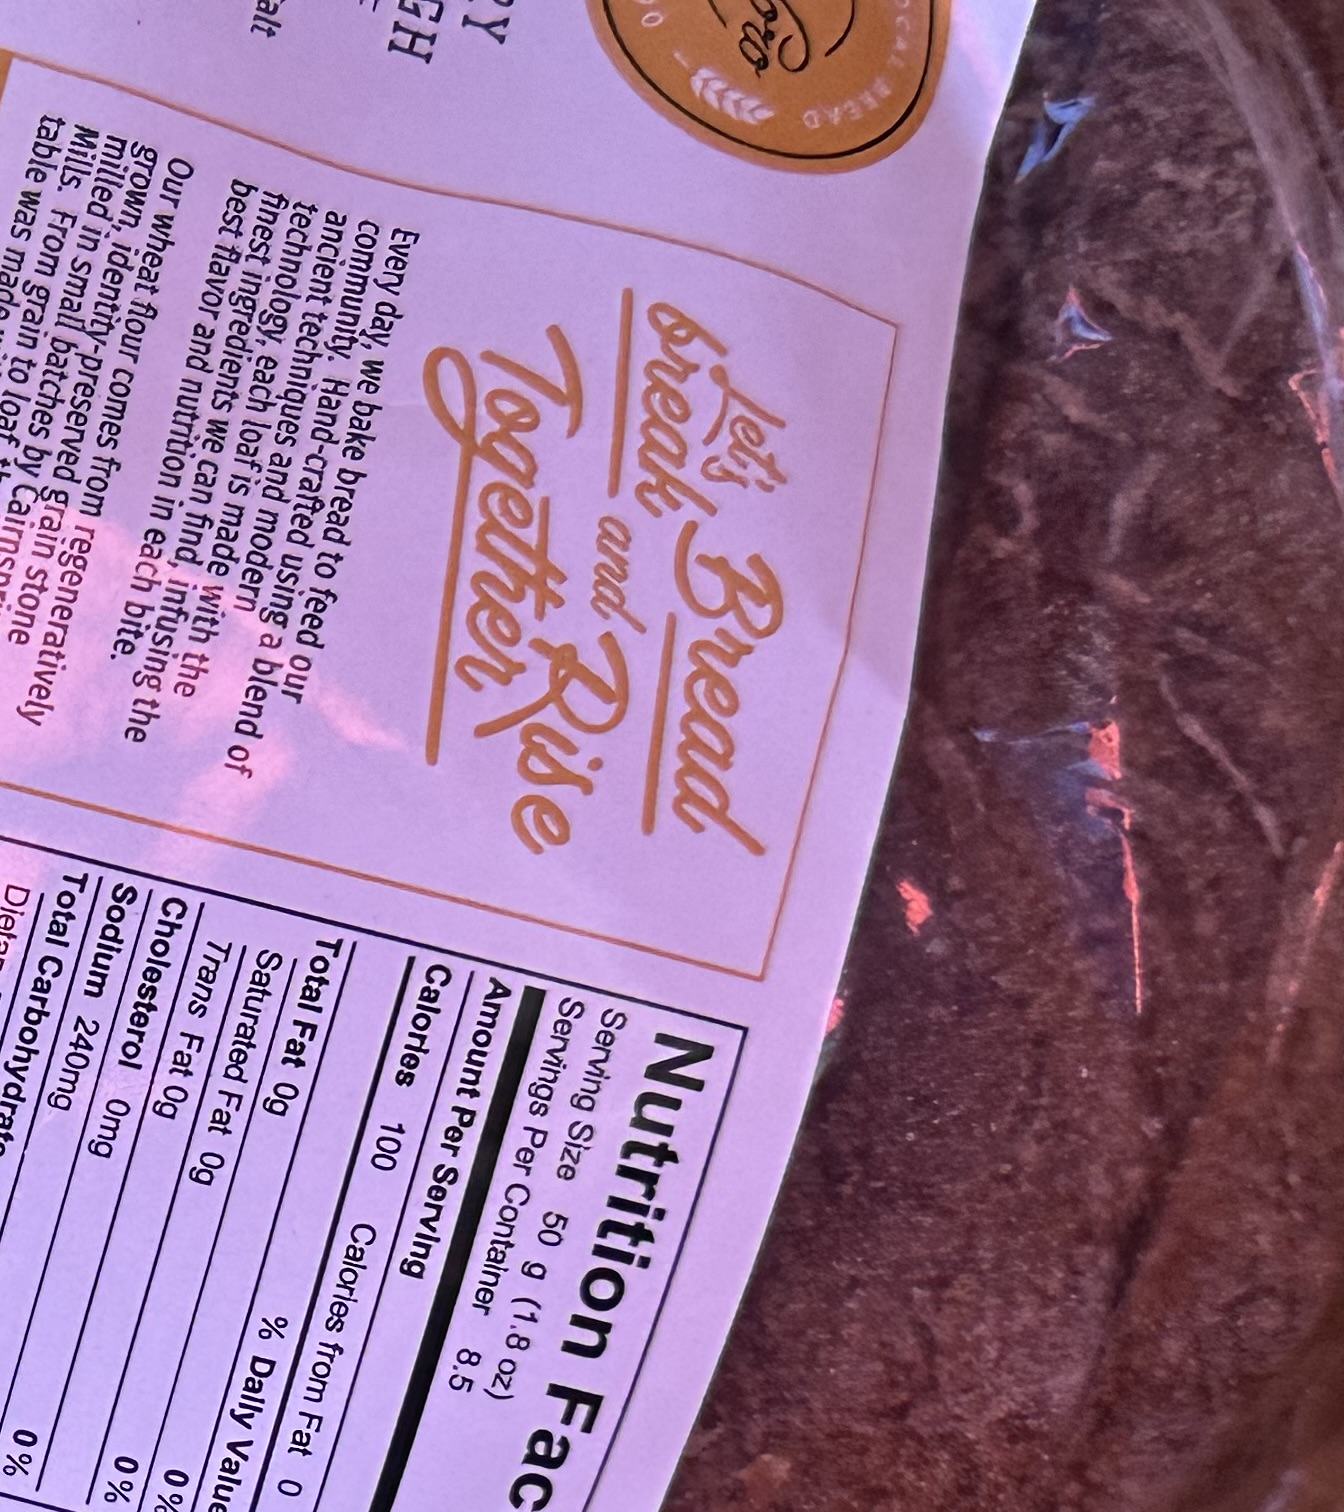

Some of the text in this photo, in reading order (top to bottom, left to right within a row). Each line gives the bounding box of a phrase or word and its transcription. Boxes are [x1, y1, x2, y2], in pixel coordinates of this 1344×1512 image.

[250, 0, 283, 39] alt
[8, 189, 44, 243] was
[23, 113, 68, 185] table
[33, 207, 79, 279] From
[56, 122, 101, 194] Mills.
[75, 223, 111, 254] in
[85, 133, 139, 223] milled
[6, 355, 39, 386] to
[6, 140, 159, 647] grown, identity-preserved grain stone
[15, 279, 52, 351] grain
[26, 334, 81, 441] batches
[53, 253, 94, 334] small
[232, 209, 349, 617] ancient techniques and modern
[7, 439, 53, 479] by
[14, 156, 196, 728] Our wheat flour comes from regeneratively
[108, 177, 261, 662] best flavor and nutrition in each bite.
[123, 189, 291, 744] finest ingredients we can find, infusing the
[172, 197, 320, 699] technology, each loaf is made with the
[223, 217, 381, 779] community. Hand-crafted using a blend of
[279, 226, 422, 706] Every day, we bake bread to feed our
[422, 323, 584, 740] Together
[700, 364, 788, 493] Let's
[473, 515, 647, 856] and Rise
[634, 301, 785, 857] break Bread
[43, 871, 91, 950] Total
[45, 881, 140, 1113] Sodium 240mg
[86, 895, 190, 1161] Cholesterol 0mg
[260, 936, 345, 1118] Total Fat 0g
[276, 962, 454, 1499] Calories 100 Calories from Fat 0
[397, 975, 514, 1281] Amount Per Serving
[447, 995, 587, 1395] Servings Per Container 8.5
[482, 1007, 630, 1402] Serving Size 50 g (1.8 oz)
[559, 1031, 717, 1360] Nutrition
[228, 1353, 278, 1431] Daily
